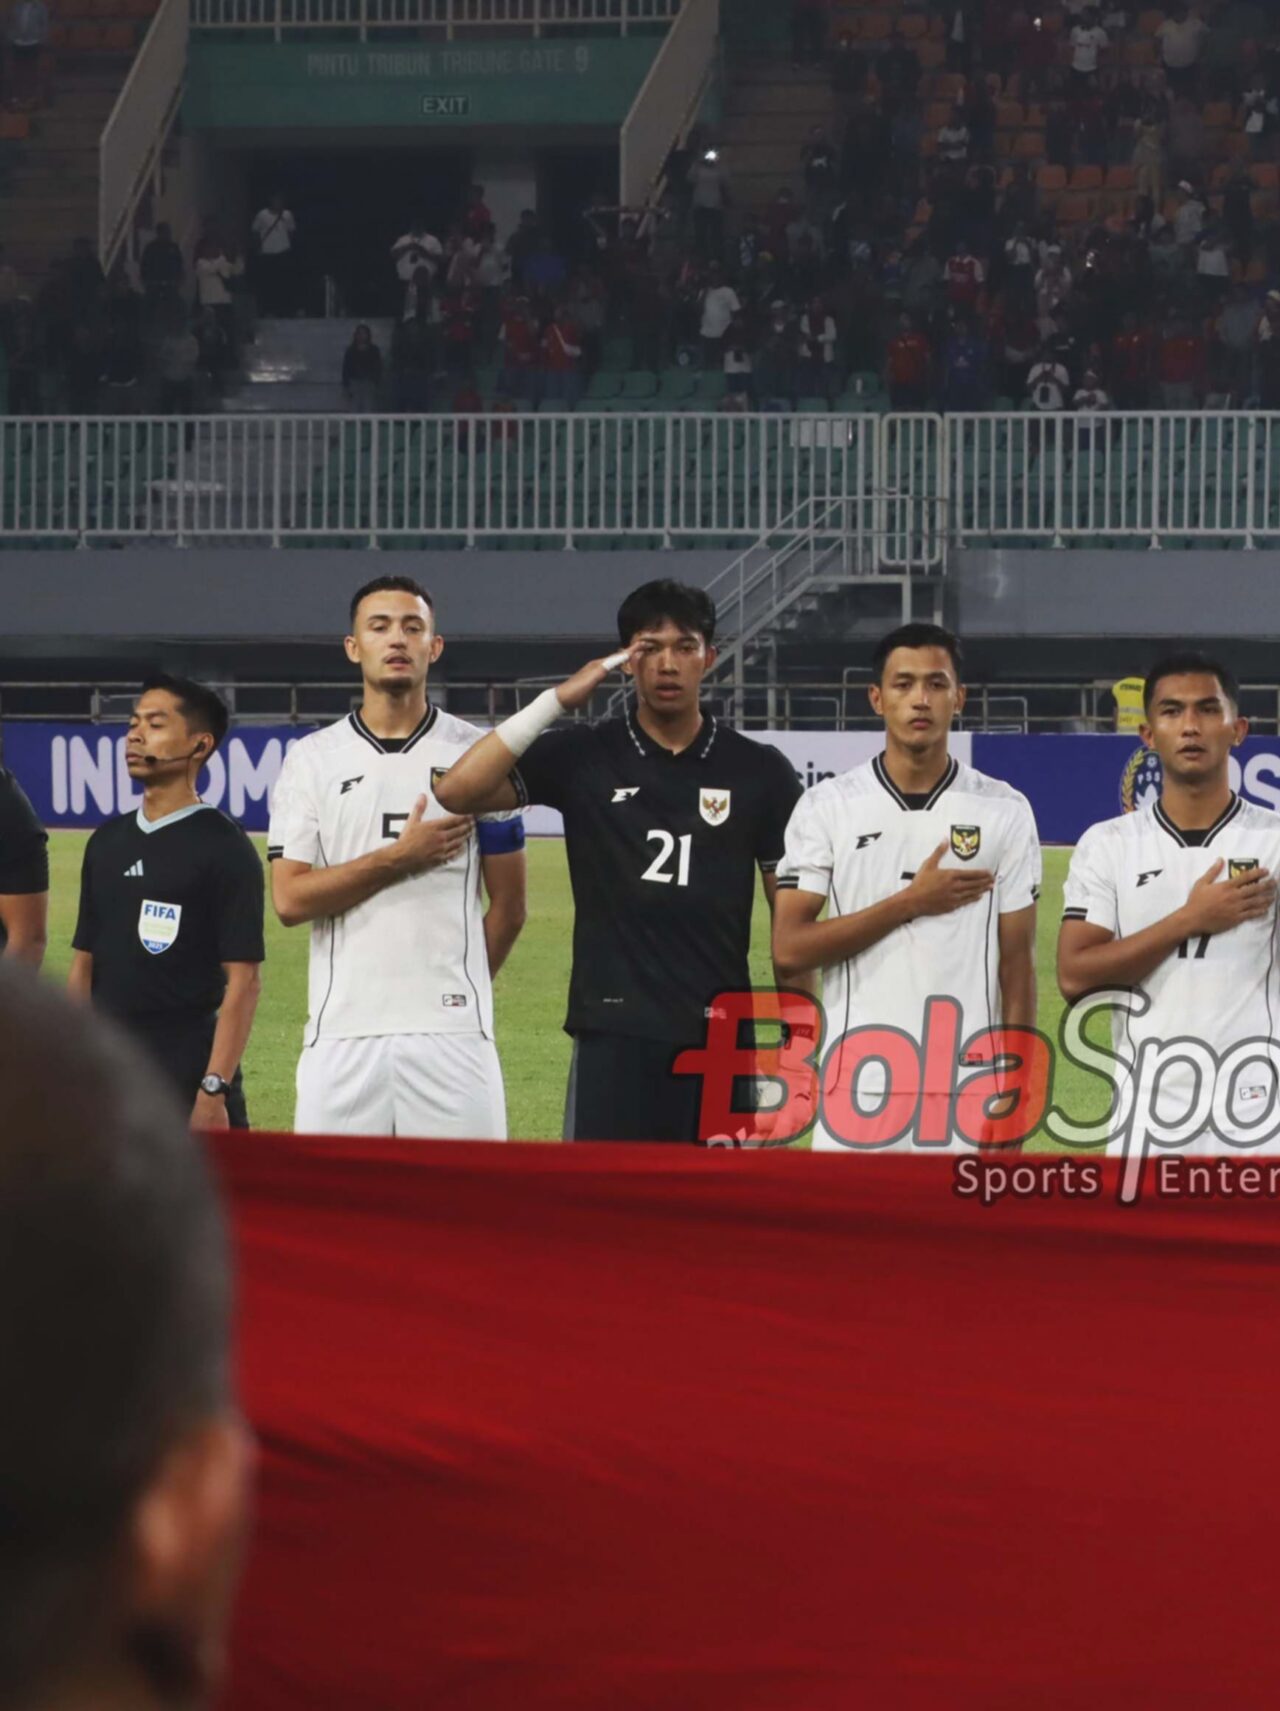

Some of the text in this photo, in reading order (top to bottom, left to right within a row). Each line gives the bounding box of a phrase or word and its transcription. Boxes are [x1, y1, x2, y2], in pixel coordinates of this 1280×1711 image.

[307, 53, 358, 76] PINTU
[368, 53, 430, 76] TRIBUN
[441, 50, 512, 74] TRIBUNE
[519, 48, 565, 72] GATE
[422, 96, 468, 114] EXIT
[641, 829, 692, 886] 21
[144, 903, 176, 920] FIFA
